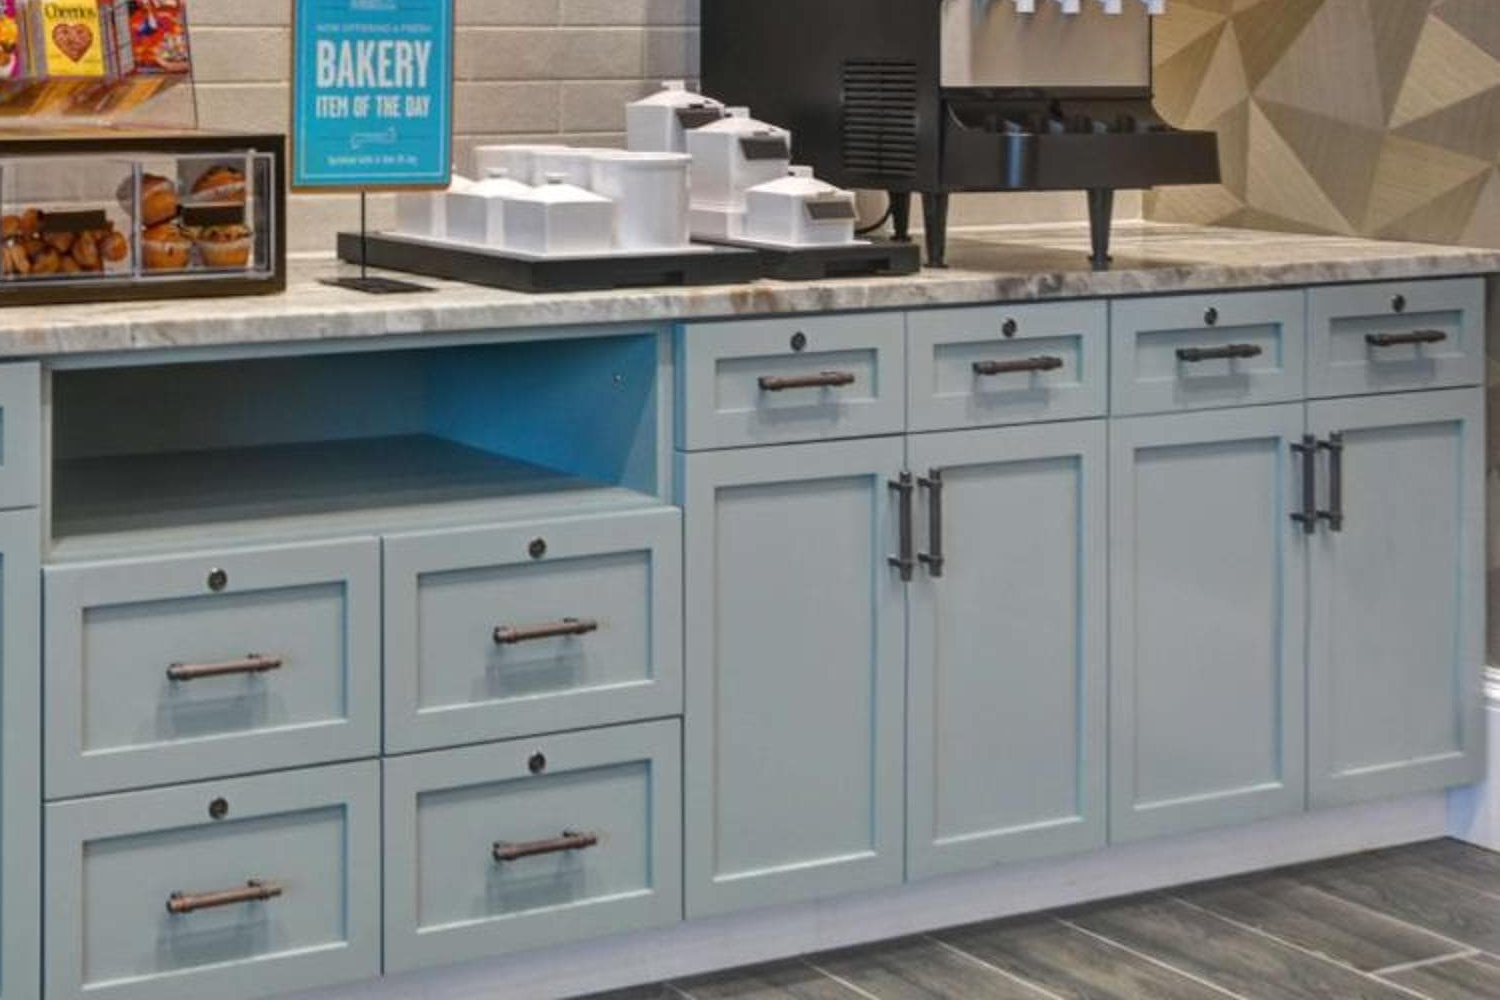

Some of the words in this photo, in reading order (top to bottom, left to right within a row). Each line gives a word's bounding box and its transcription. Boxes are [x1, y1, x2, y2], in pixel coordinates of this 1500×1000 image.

[45, 2, 97, 20] Cheerios
[316, 39, 432, 89] BAKERY
[315, 95, 349, 119] ITEM
[352, 95, 371, 118] OF
[376, 95, 401, 118] THE
[405, 95, 431, 118] DAY
